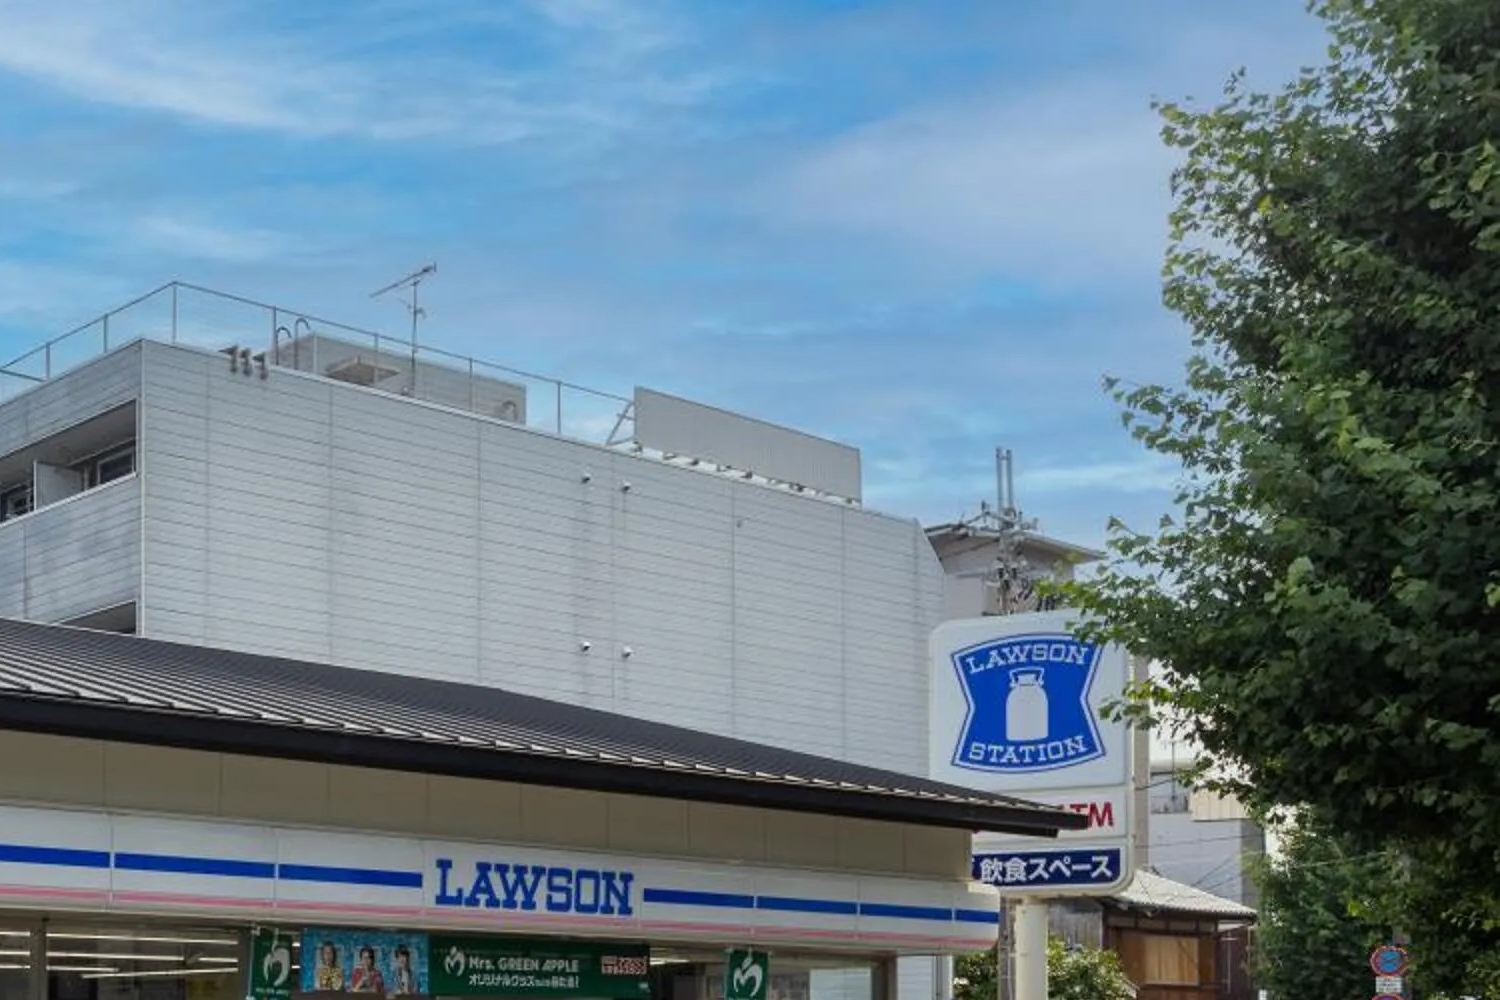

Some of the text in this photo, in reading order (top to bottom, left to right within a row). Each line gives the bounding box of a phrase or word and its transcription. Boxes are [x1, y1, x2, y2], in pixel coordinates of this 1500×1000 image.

[965, 643, 1090, 674] LAWSON
[968, 735, 1087, 765] STATION
[979, 855, 1113, 883] 飲食スペース
[436, 858, 634, 915] LAWSON
[498, 957, 539, 971] GREEN
[541, 959, 579, 973] APPLE
